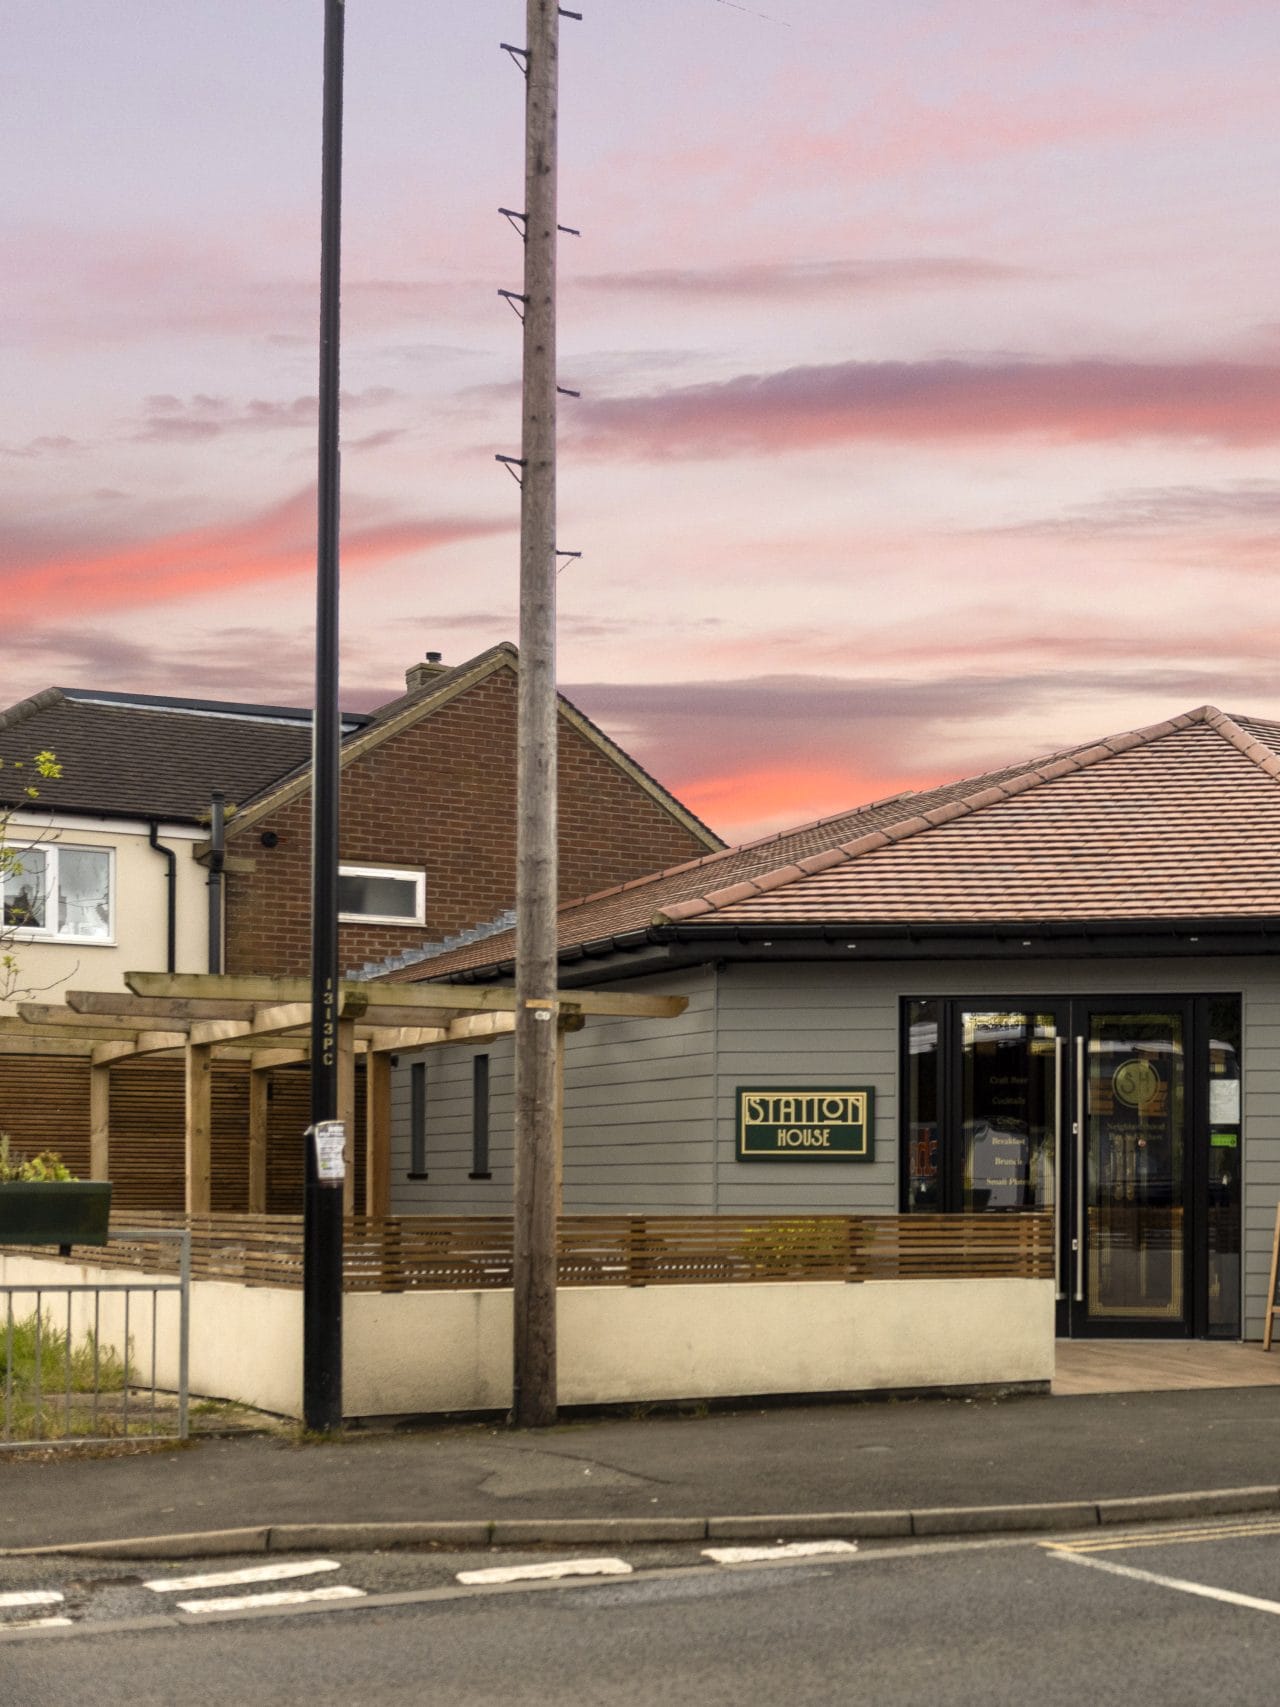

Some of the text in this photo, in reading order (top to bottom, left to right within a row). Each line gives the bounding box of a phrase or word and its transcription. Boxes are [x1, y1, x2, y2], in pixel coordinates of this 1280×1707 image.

[747, 1097, 863, 1124] STATION
[777, 1129, 831, 1147] HOUSE
[991, 1136, 1026, 1145] Breakfast
[994, 1157, 1023, 1165] Brunch
